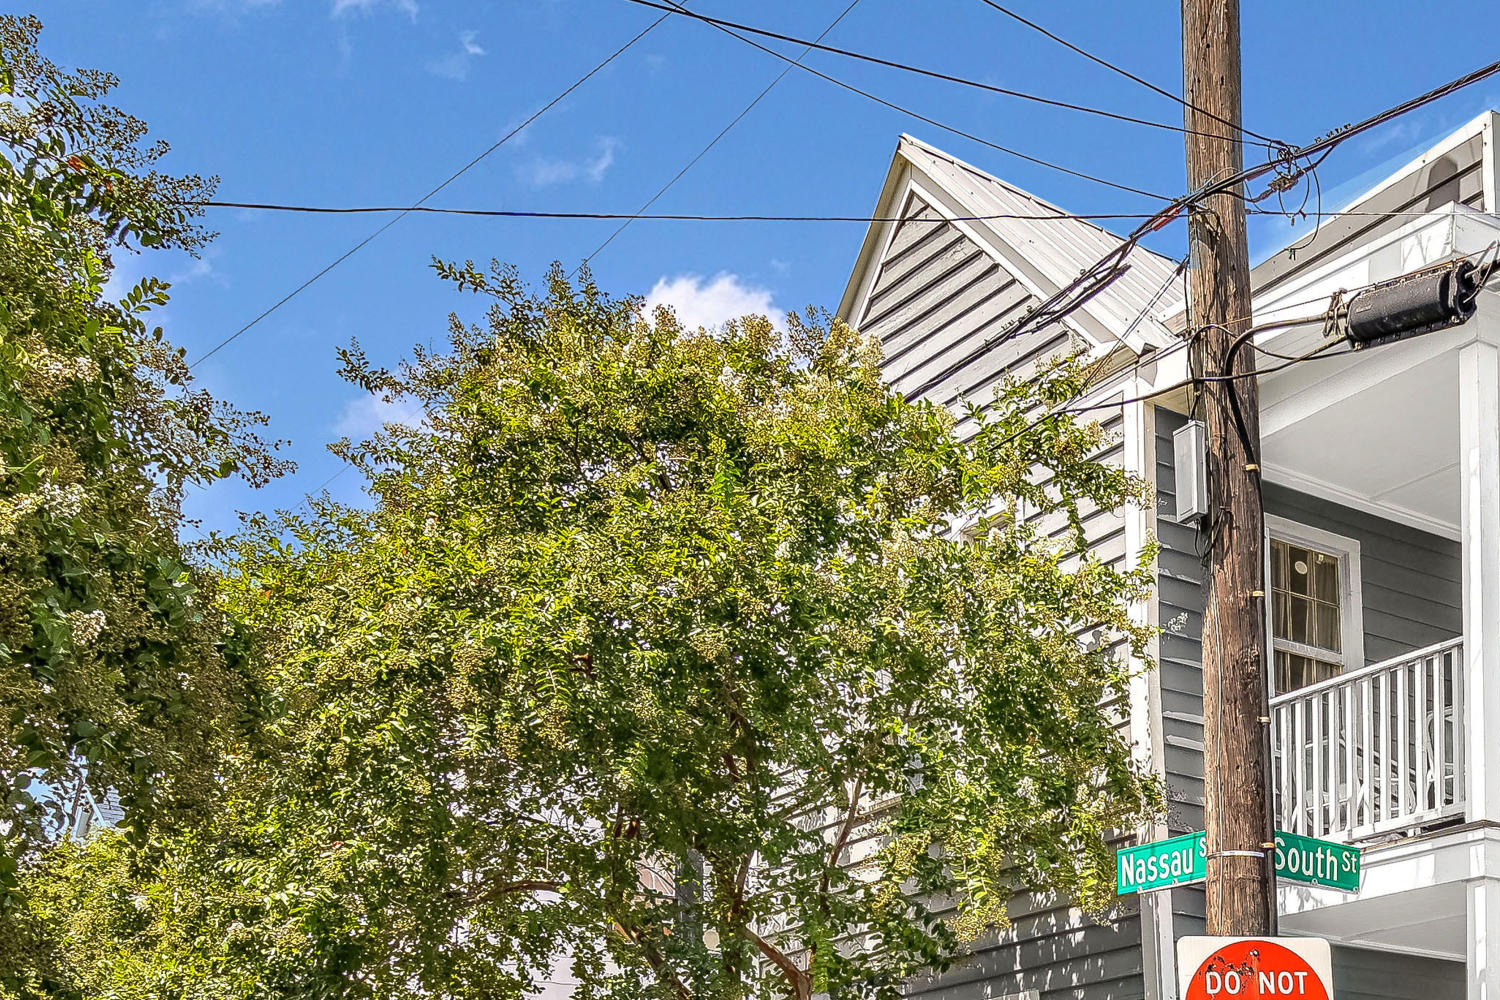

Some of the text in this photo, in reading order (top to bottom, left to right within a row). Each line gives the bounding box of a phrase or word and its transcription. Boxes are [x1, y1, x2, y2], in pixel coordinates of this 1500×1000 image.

[1121, 848, 1194, 887] Nassau
[1274, 836, 1357, 881] South St
[1205, 971, 1308, 995] DO NOT
